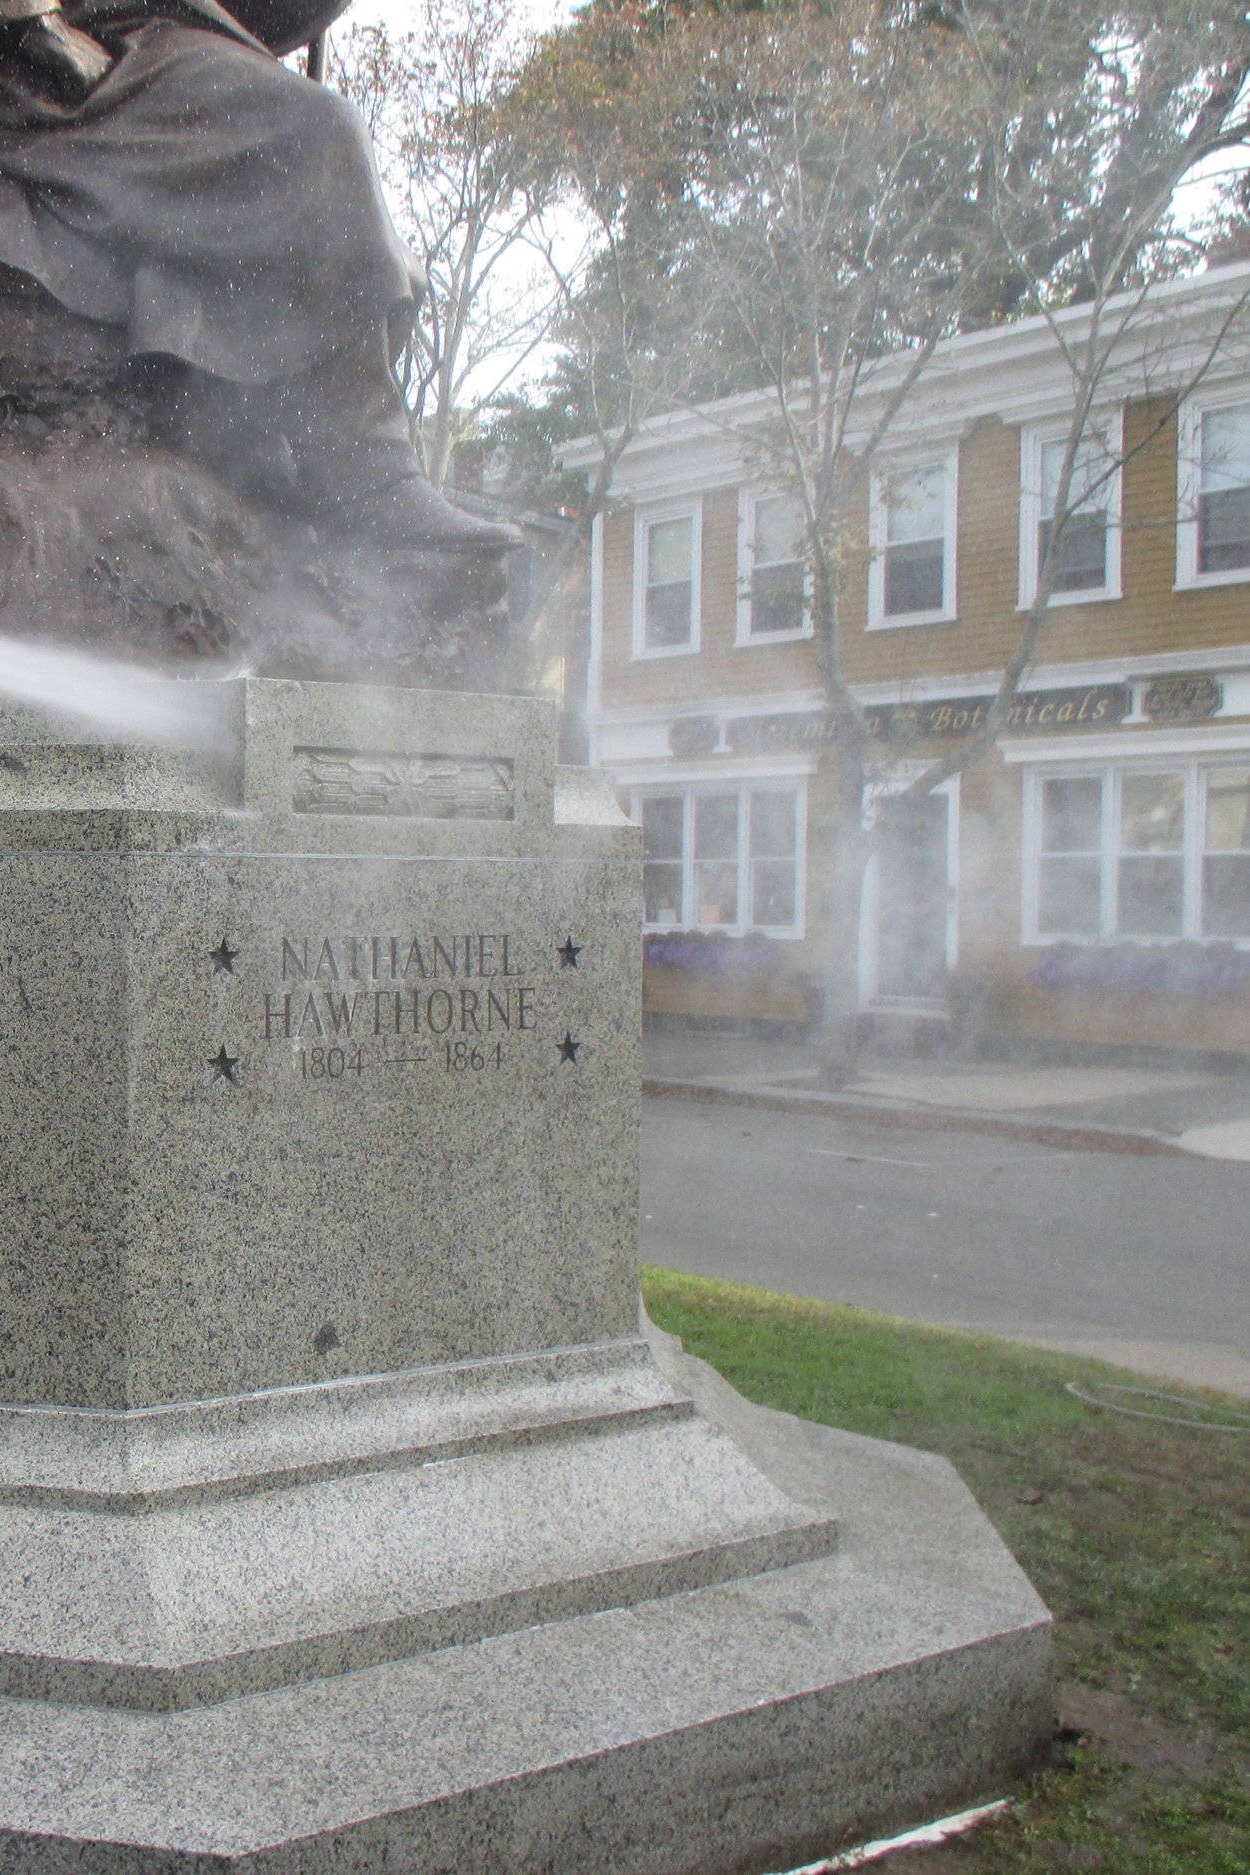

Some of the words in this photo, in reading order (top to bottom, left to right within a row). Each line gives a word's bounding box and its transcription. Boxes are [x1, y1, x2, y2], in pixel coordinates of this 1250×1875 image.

[930, 687, 1109, 731] Botnicals
[280, 934, 524, 982] NATHANIEL
[263, 987, 536, 1039] HAWTHORNE
[300, 1047, 364, 1079] 1804
[443, 1041, 503, 1073] 1864
